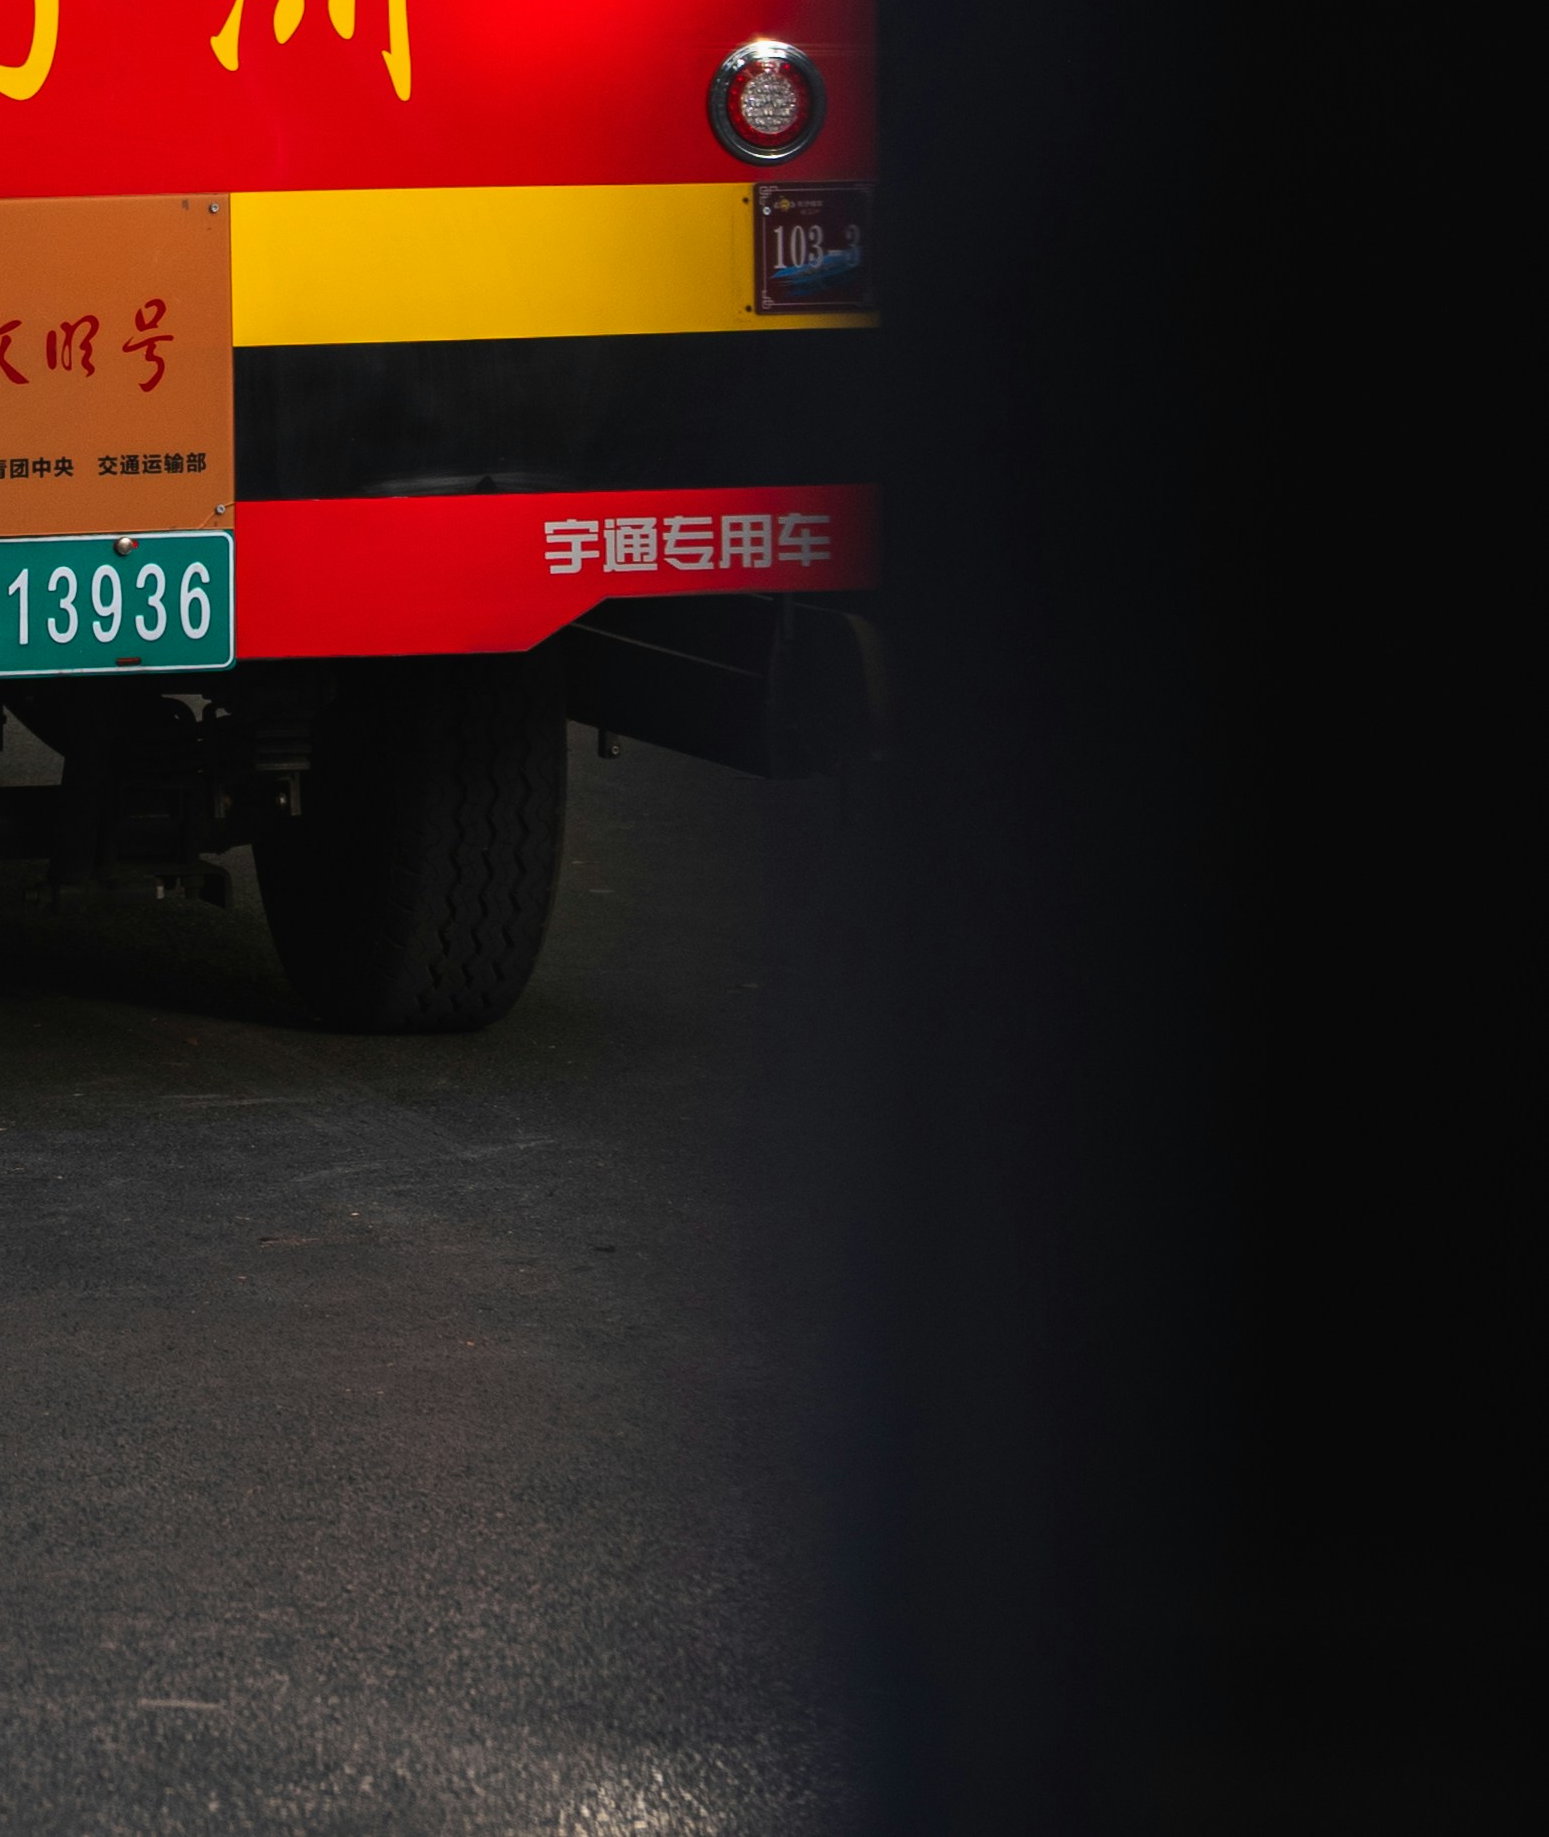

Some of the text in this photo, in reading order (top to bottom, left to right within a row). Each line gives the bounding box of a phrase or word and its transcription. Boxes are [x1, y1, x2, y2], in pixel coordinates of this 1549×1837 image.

[97, 452, 207, 477] 交通运输部
[544, 513, 831, 575] 宇通专用车
